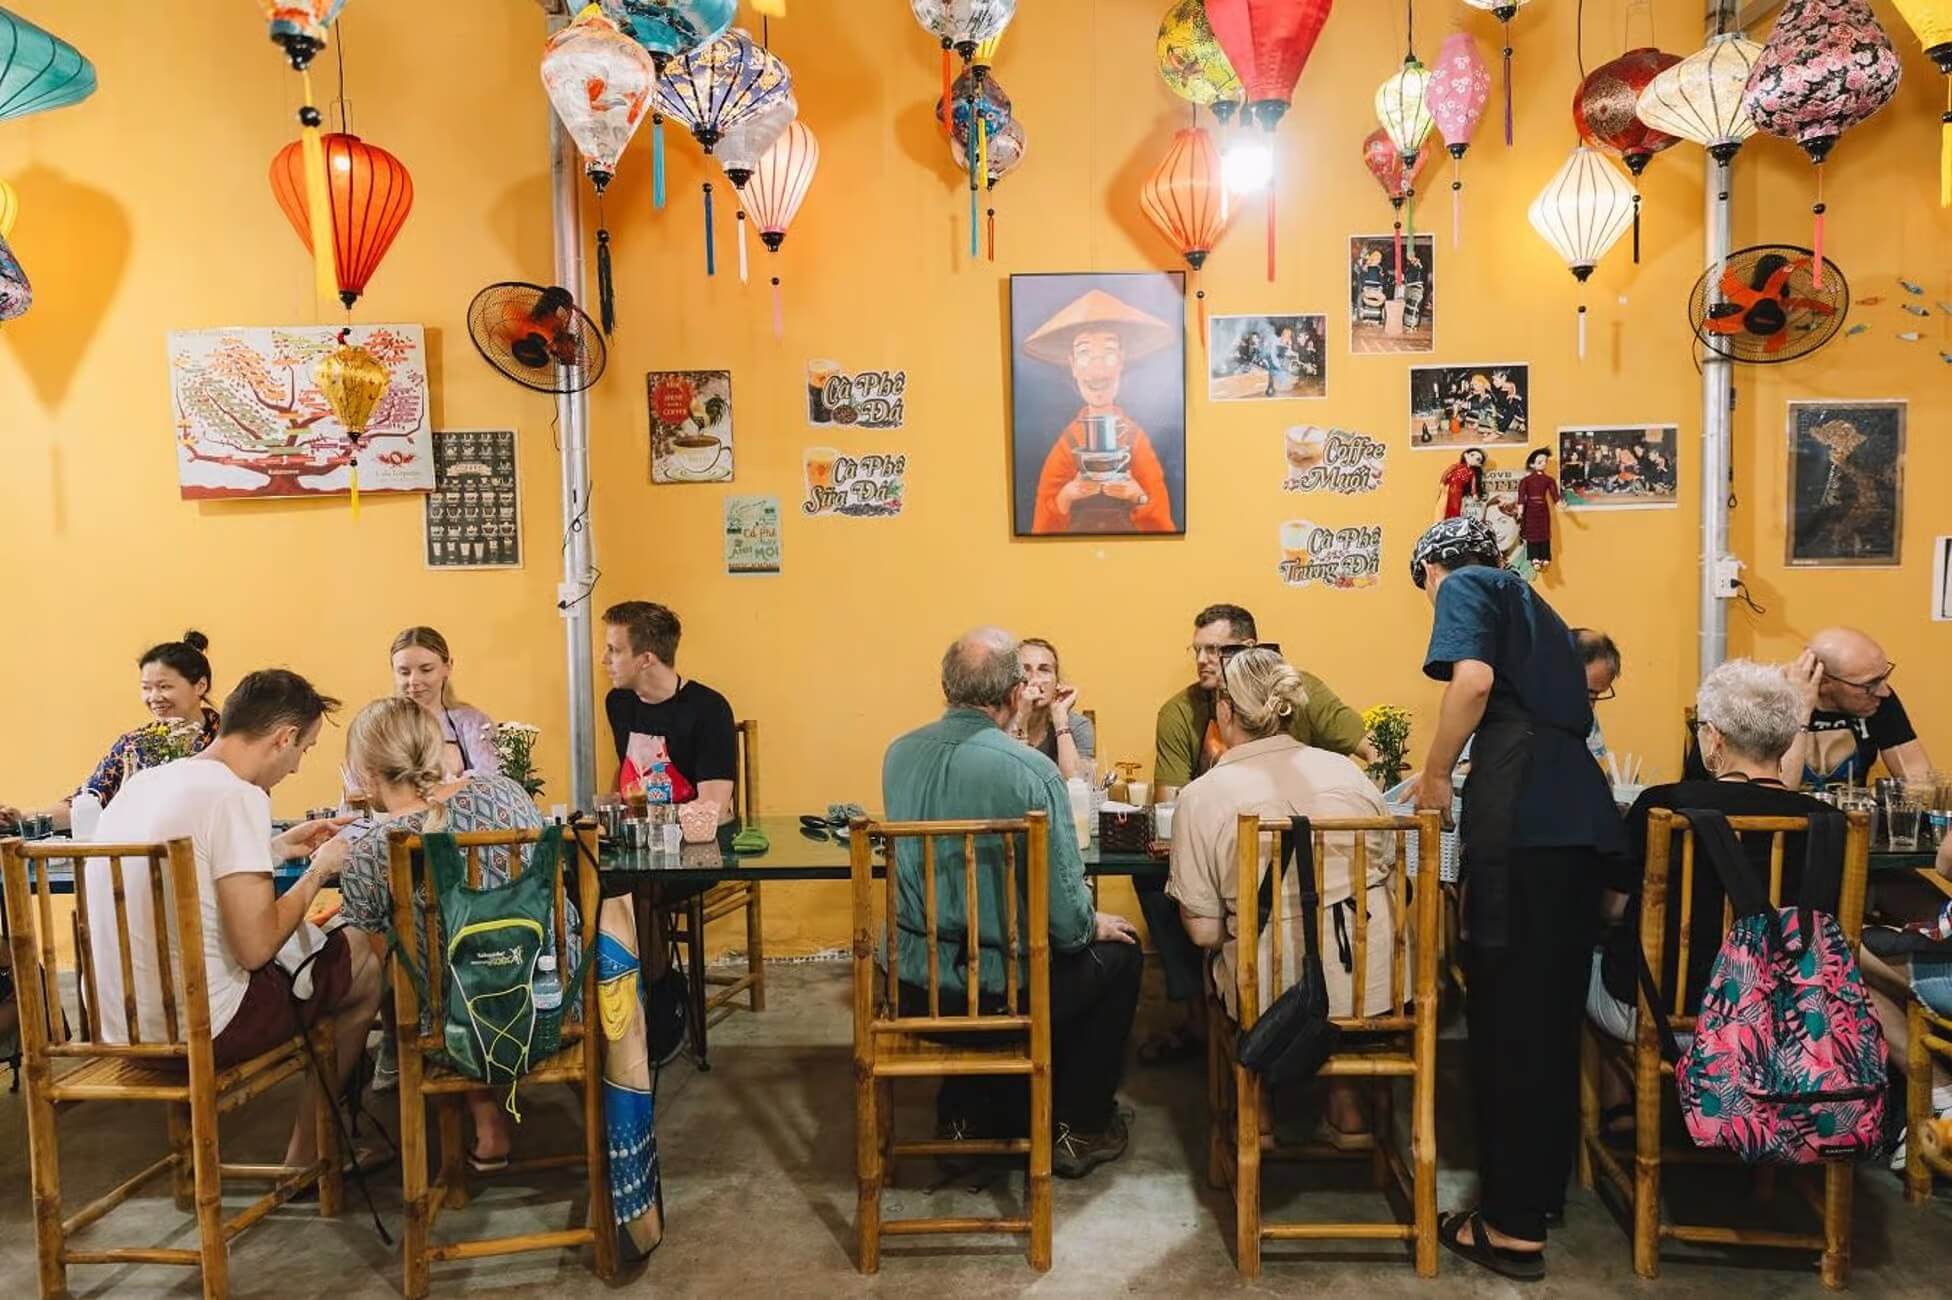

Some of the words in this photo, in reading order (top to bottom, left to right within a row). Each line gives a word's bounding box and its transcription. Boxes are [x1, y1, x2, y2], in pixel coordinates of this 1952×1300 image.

[822, 375, 852, 409] Cà
[855, 371, 905, 397] Phê
[1323, 436, 1385, 467] Coffee
[833, 457, 857, 486] Cà
[860, 454, 906, 477] Phê
[1307, 527, 1335, 556] Cà
[1336, 526, 1382, 548] Phê
